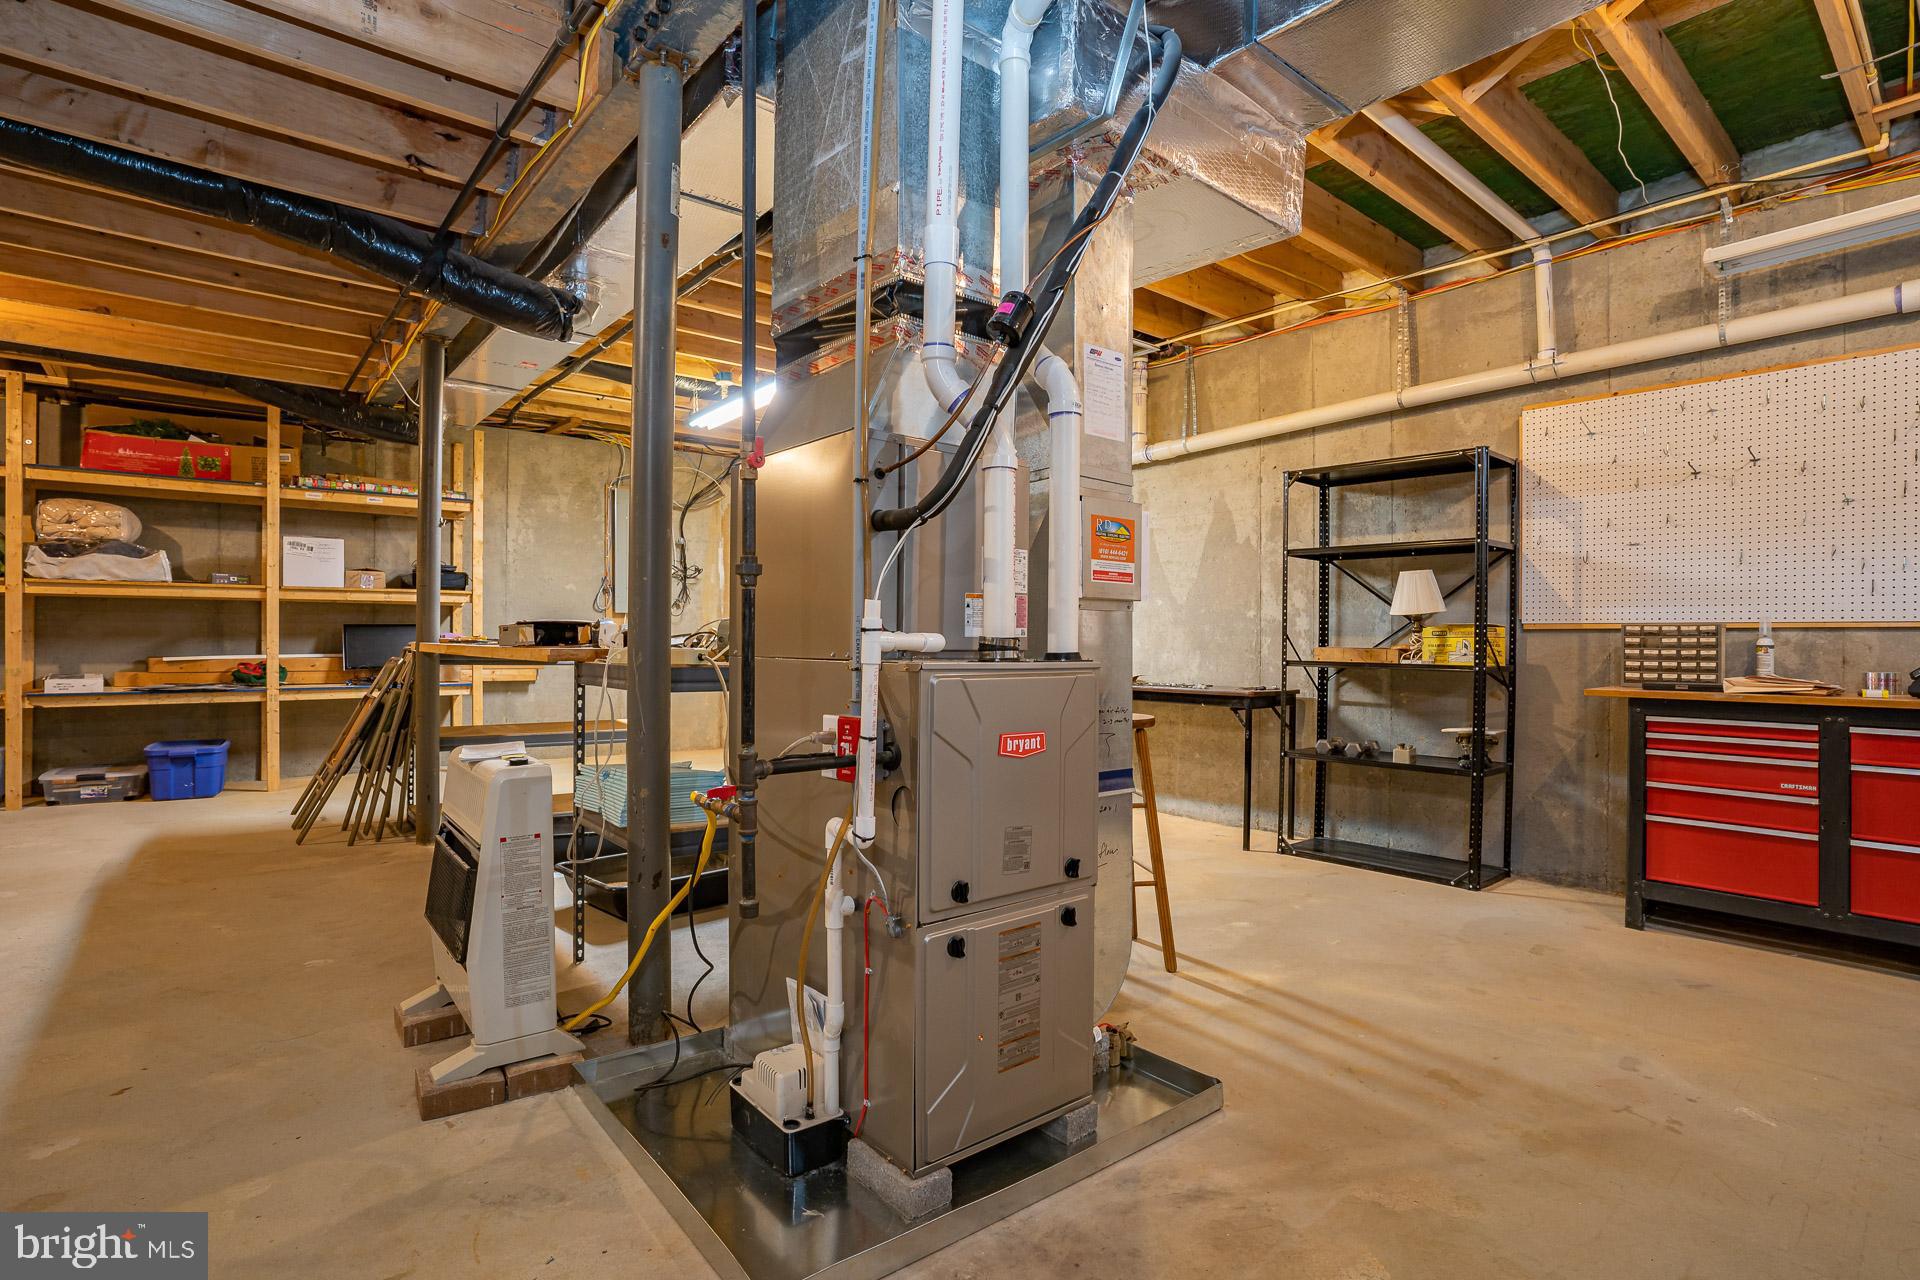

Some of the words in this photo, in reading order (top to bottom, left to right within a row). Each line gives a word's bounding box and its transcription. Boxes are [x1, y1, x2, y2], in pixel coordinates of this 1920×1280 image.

[935, 188, 943, 216] PIPE
[1006, 735, 1041, 753] bryant
[1780, 783, 1817, 791] CRAFTSMAN
